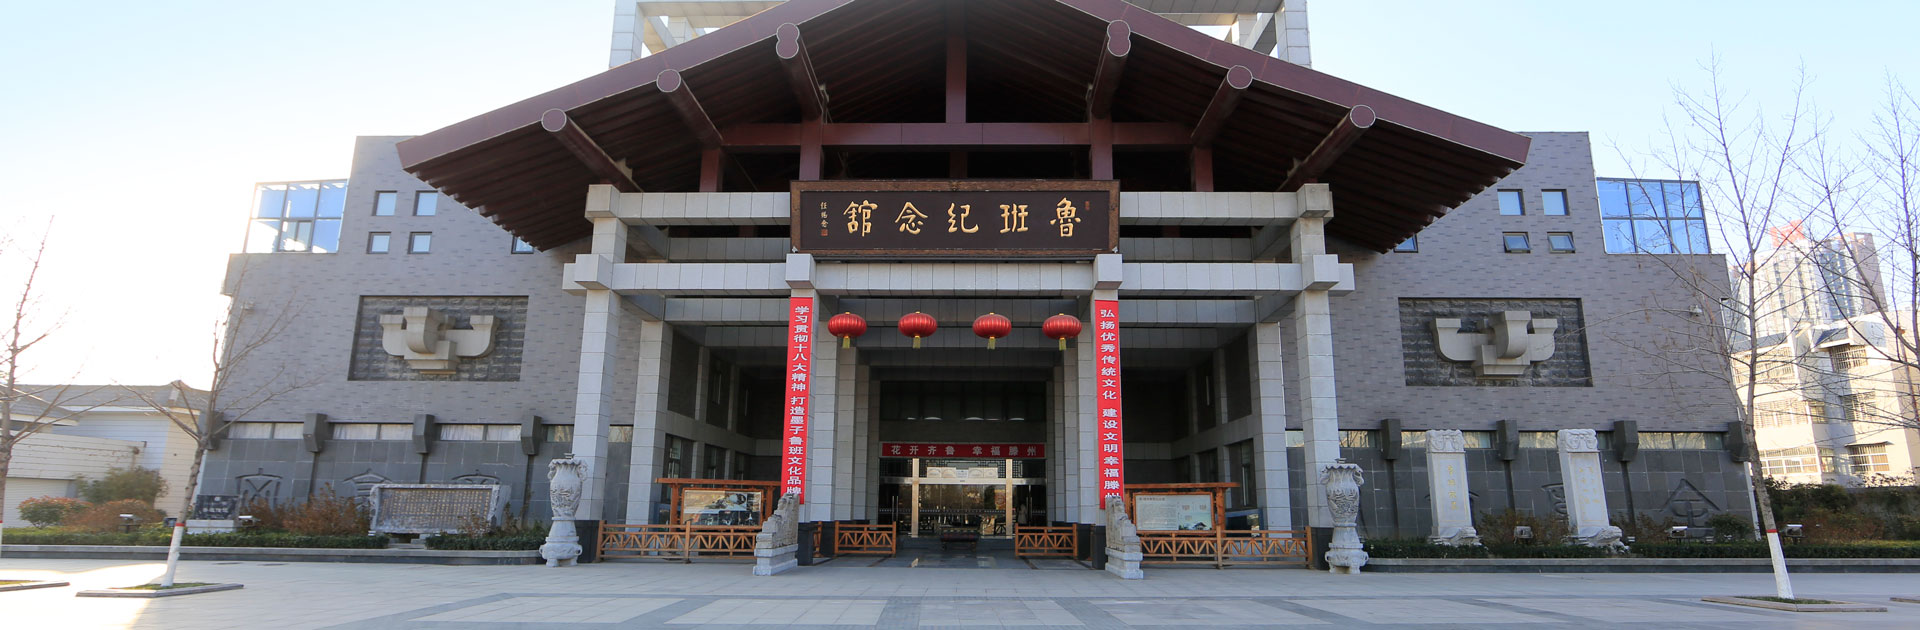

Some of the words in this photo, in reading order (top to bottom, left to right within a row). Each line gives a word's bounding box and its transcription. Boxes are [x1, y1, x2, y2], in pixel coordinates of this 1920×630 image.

[791, 305, 810, 392] 学习贯彻十八大精神
[1100, 309, 1117, 400] 弘扬优秀传统文化
[786, 396, 806, 495] 打造墨子鲁班文化品牌
[891, 445, 955, 456] 花开齐鲁
[972, 446, 1037, 456] 幸福滕州
